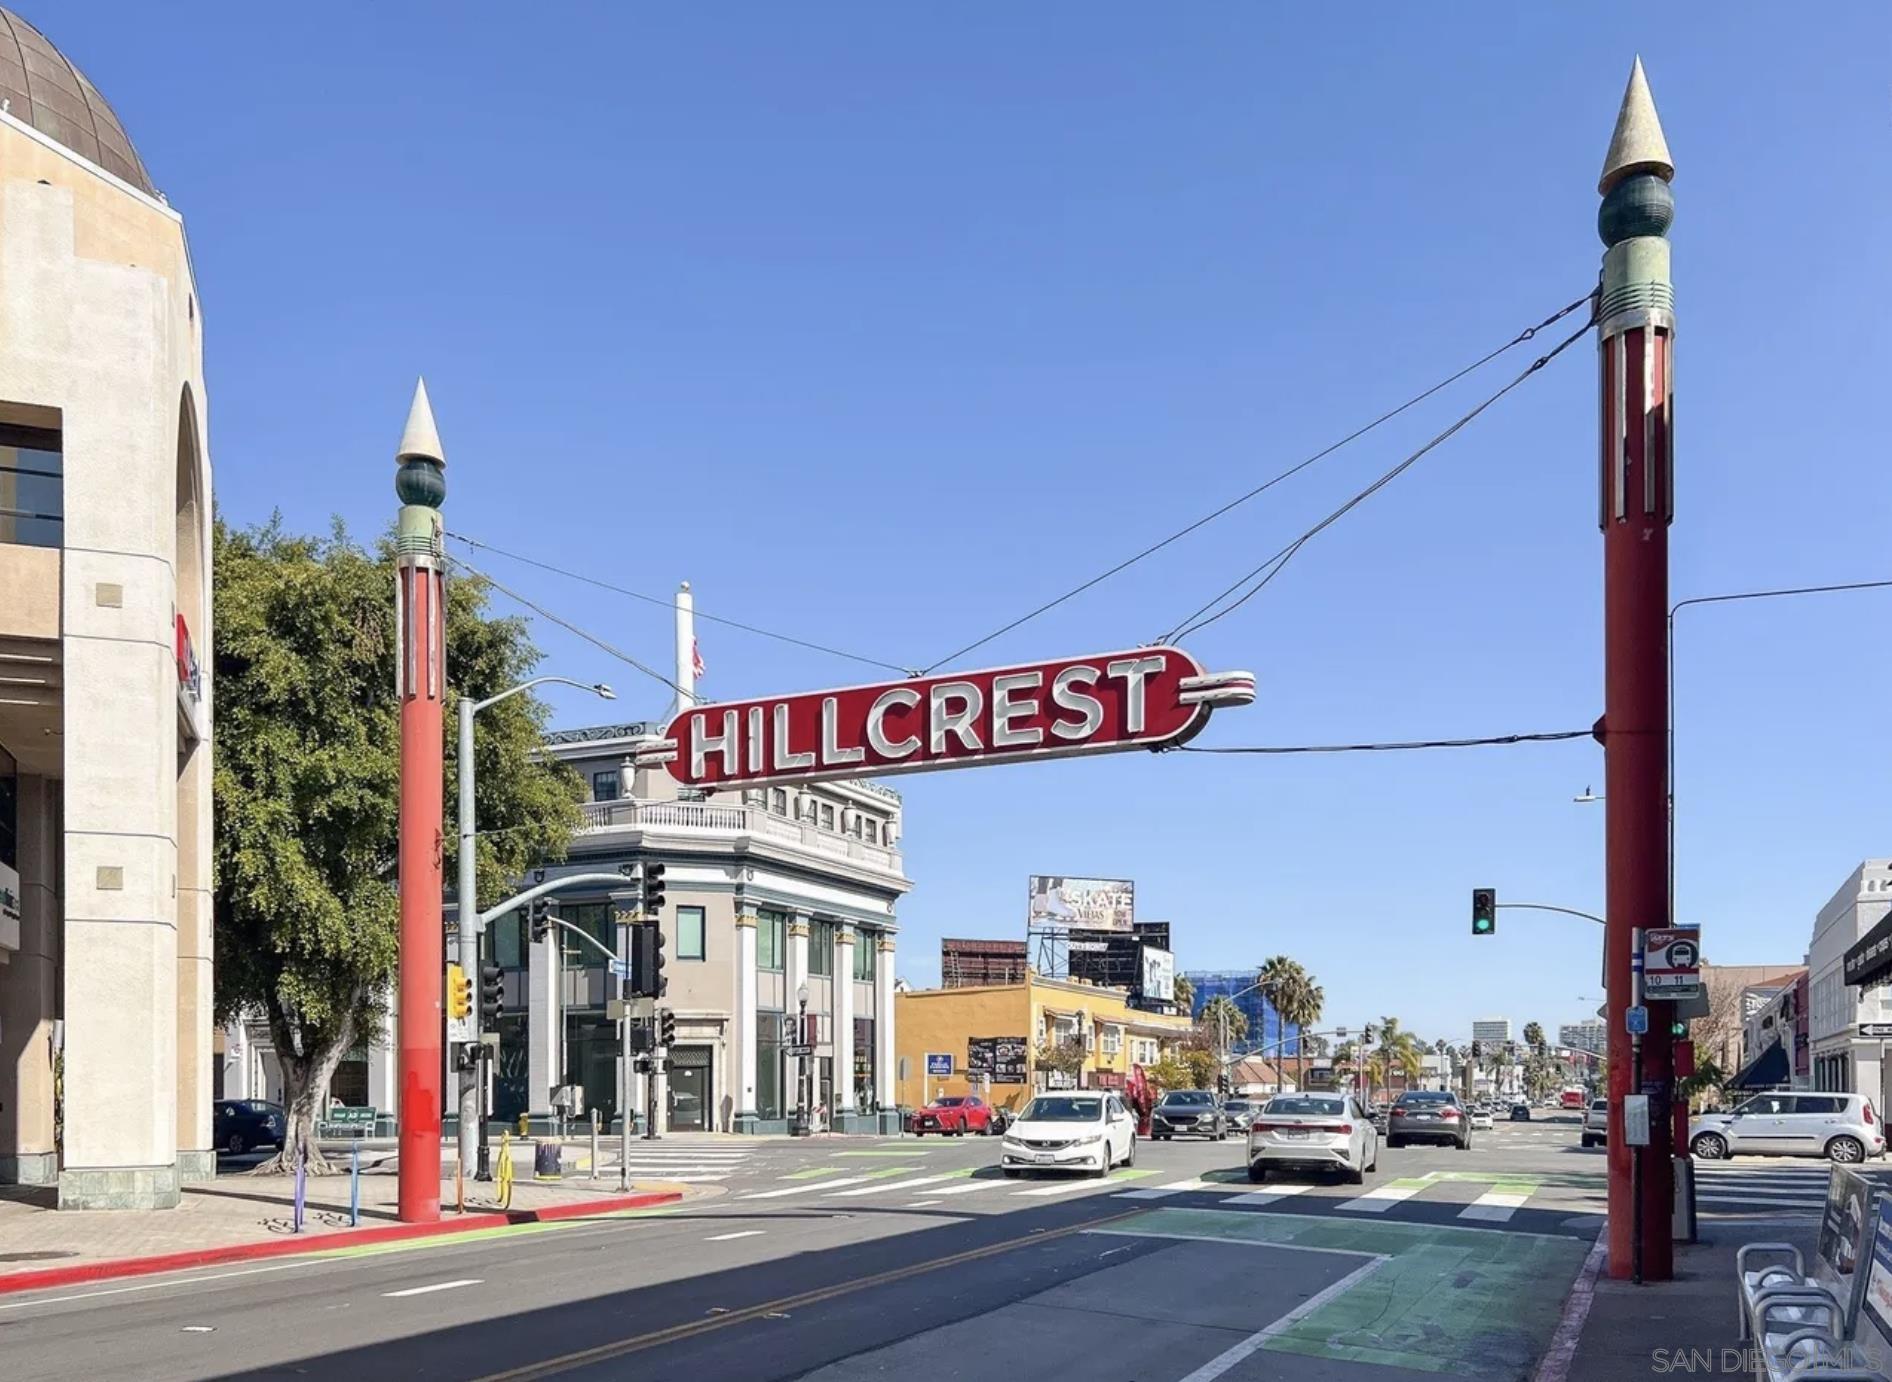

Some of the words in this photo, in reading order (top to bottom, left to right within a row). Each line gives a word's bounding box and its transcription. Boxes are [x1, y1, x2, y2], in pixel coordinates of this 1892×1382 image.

[690, 655, 1167, 779] HILLCREST
[1070, 889, 1132, 910] SKATE
[1650, 975, 1662, 986] 10
[1674, 975, 1684, 985] 11
